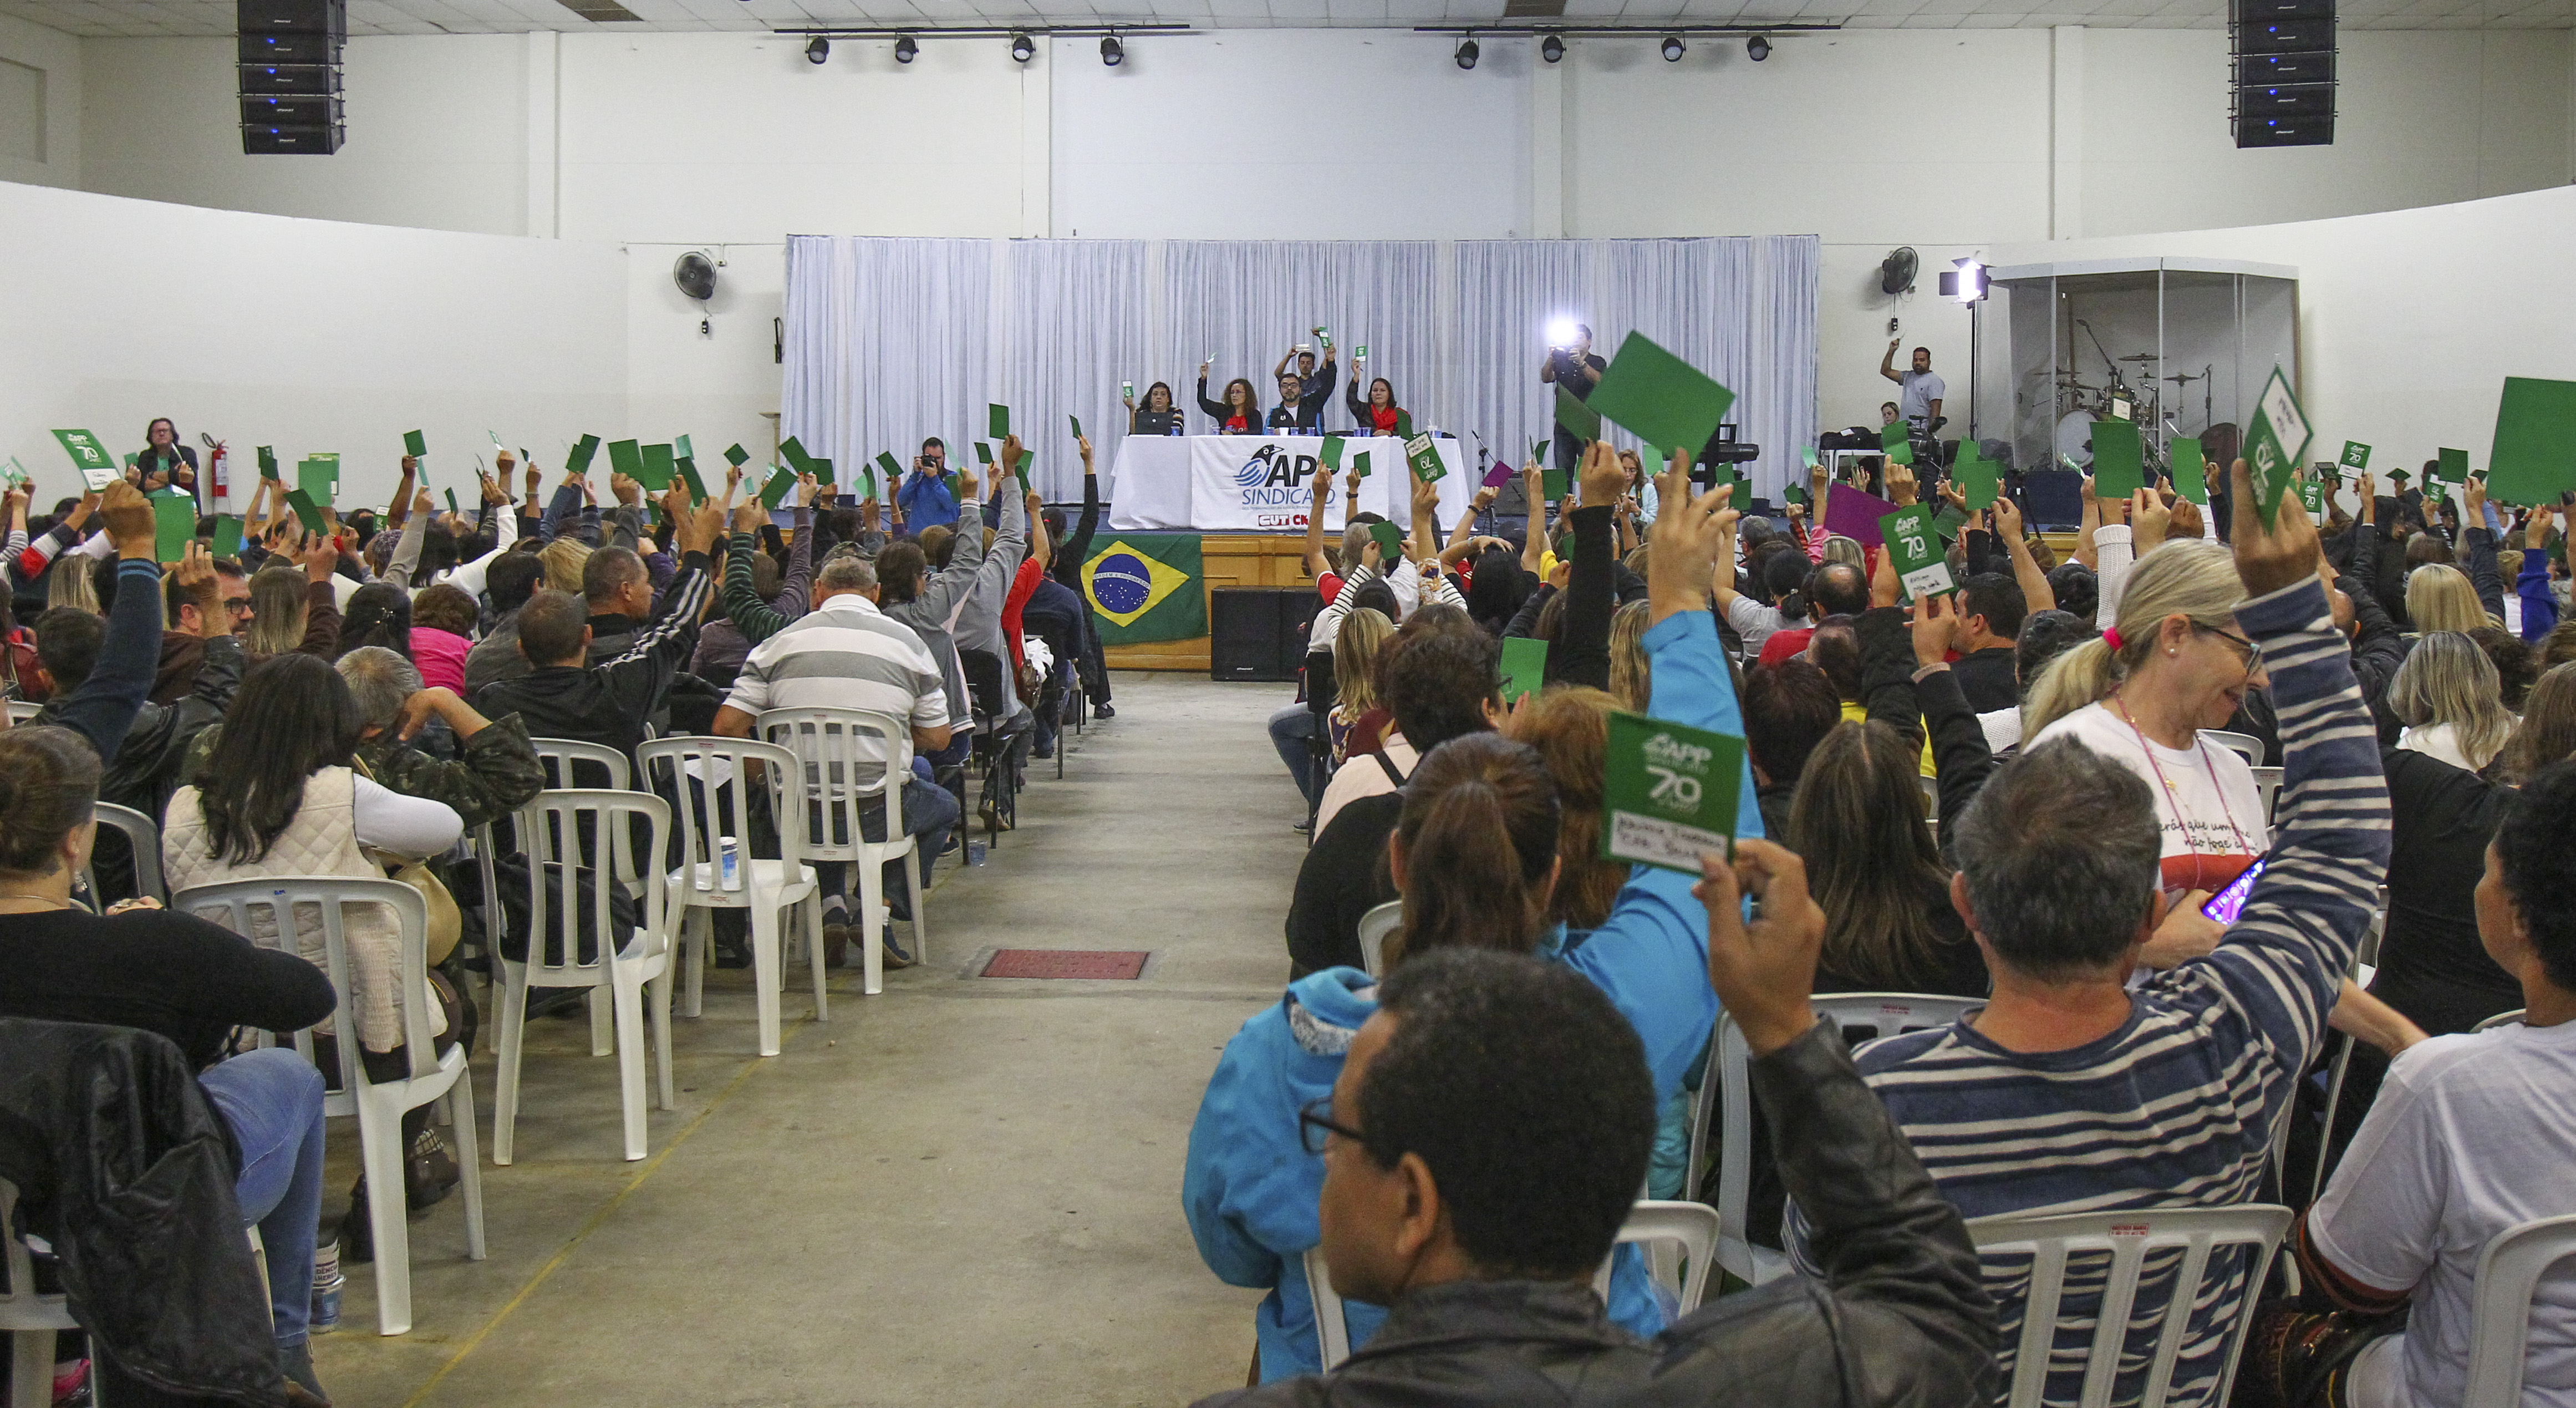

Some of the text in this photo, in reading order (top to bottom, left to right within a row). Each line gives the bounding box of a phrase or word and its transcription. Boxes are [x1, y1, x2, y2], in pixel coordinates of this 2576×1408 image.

[75, 445, 99, 460] 70
[2349, 452, 2361, 462] 70
[1265, 455, 1340, 487] AP
[1242, 488, 1336, 505] SINDICAO
[2305, 495, 2316, 505] 70
[1259, 515, 1289, 526] CUT
[1900, 536, 1926, 558] 70
[1120, 574, 1149, 587] PROGRESSO
[1647, 765, 1703, 804] 70
[2188, 819, 2208, 833] que
[2184, 836, 2205, 848] não
